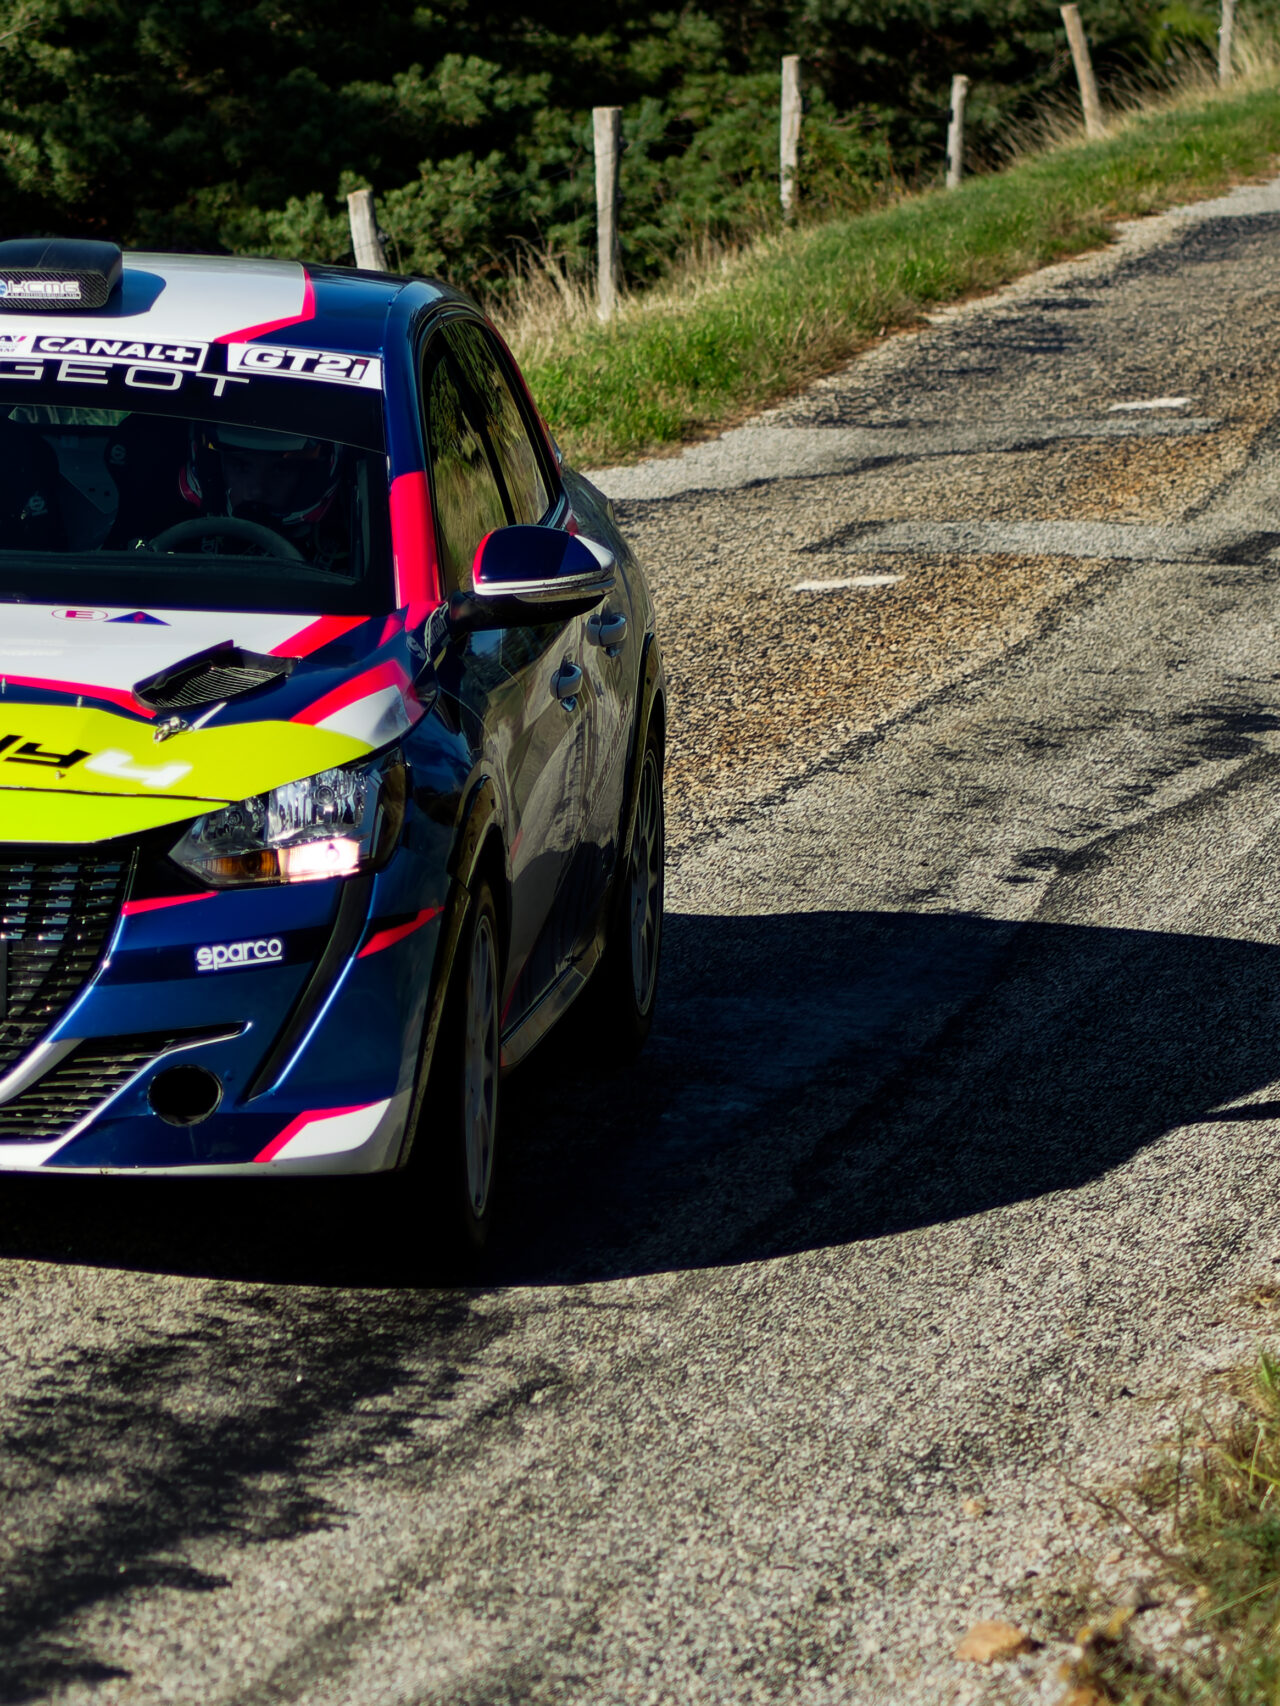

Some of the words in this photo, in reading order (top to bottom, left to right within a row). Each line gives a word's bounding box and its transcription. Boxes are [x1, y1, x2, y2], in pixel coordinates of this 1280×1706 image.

[38, 337, 196, 362] CANAL+
[244, 347, 369, 380] GT2i
[196, 938, 282, 970] sparco
